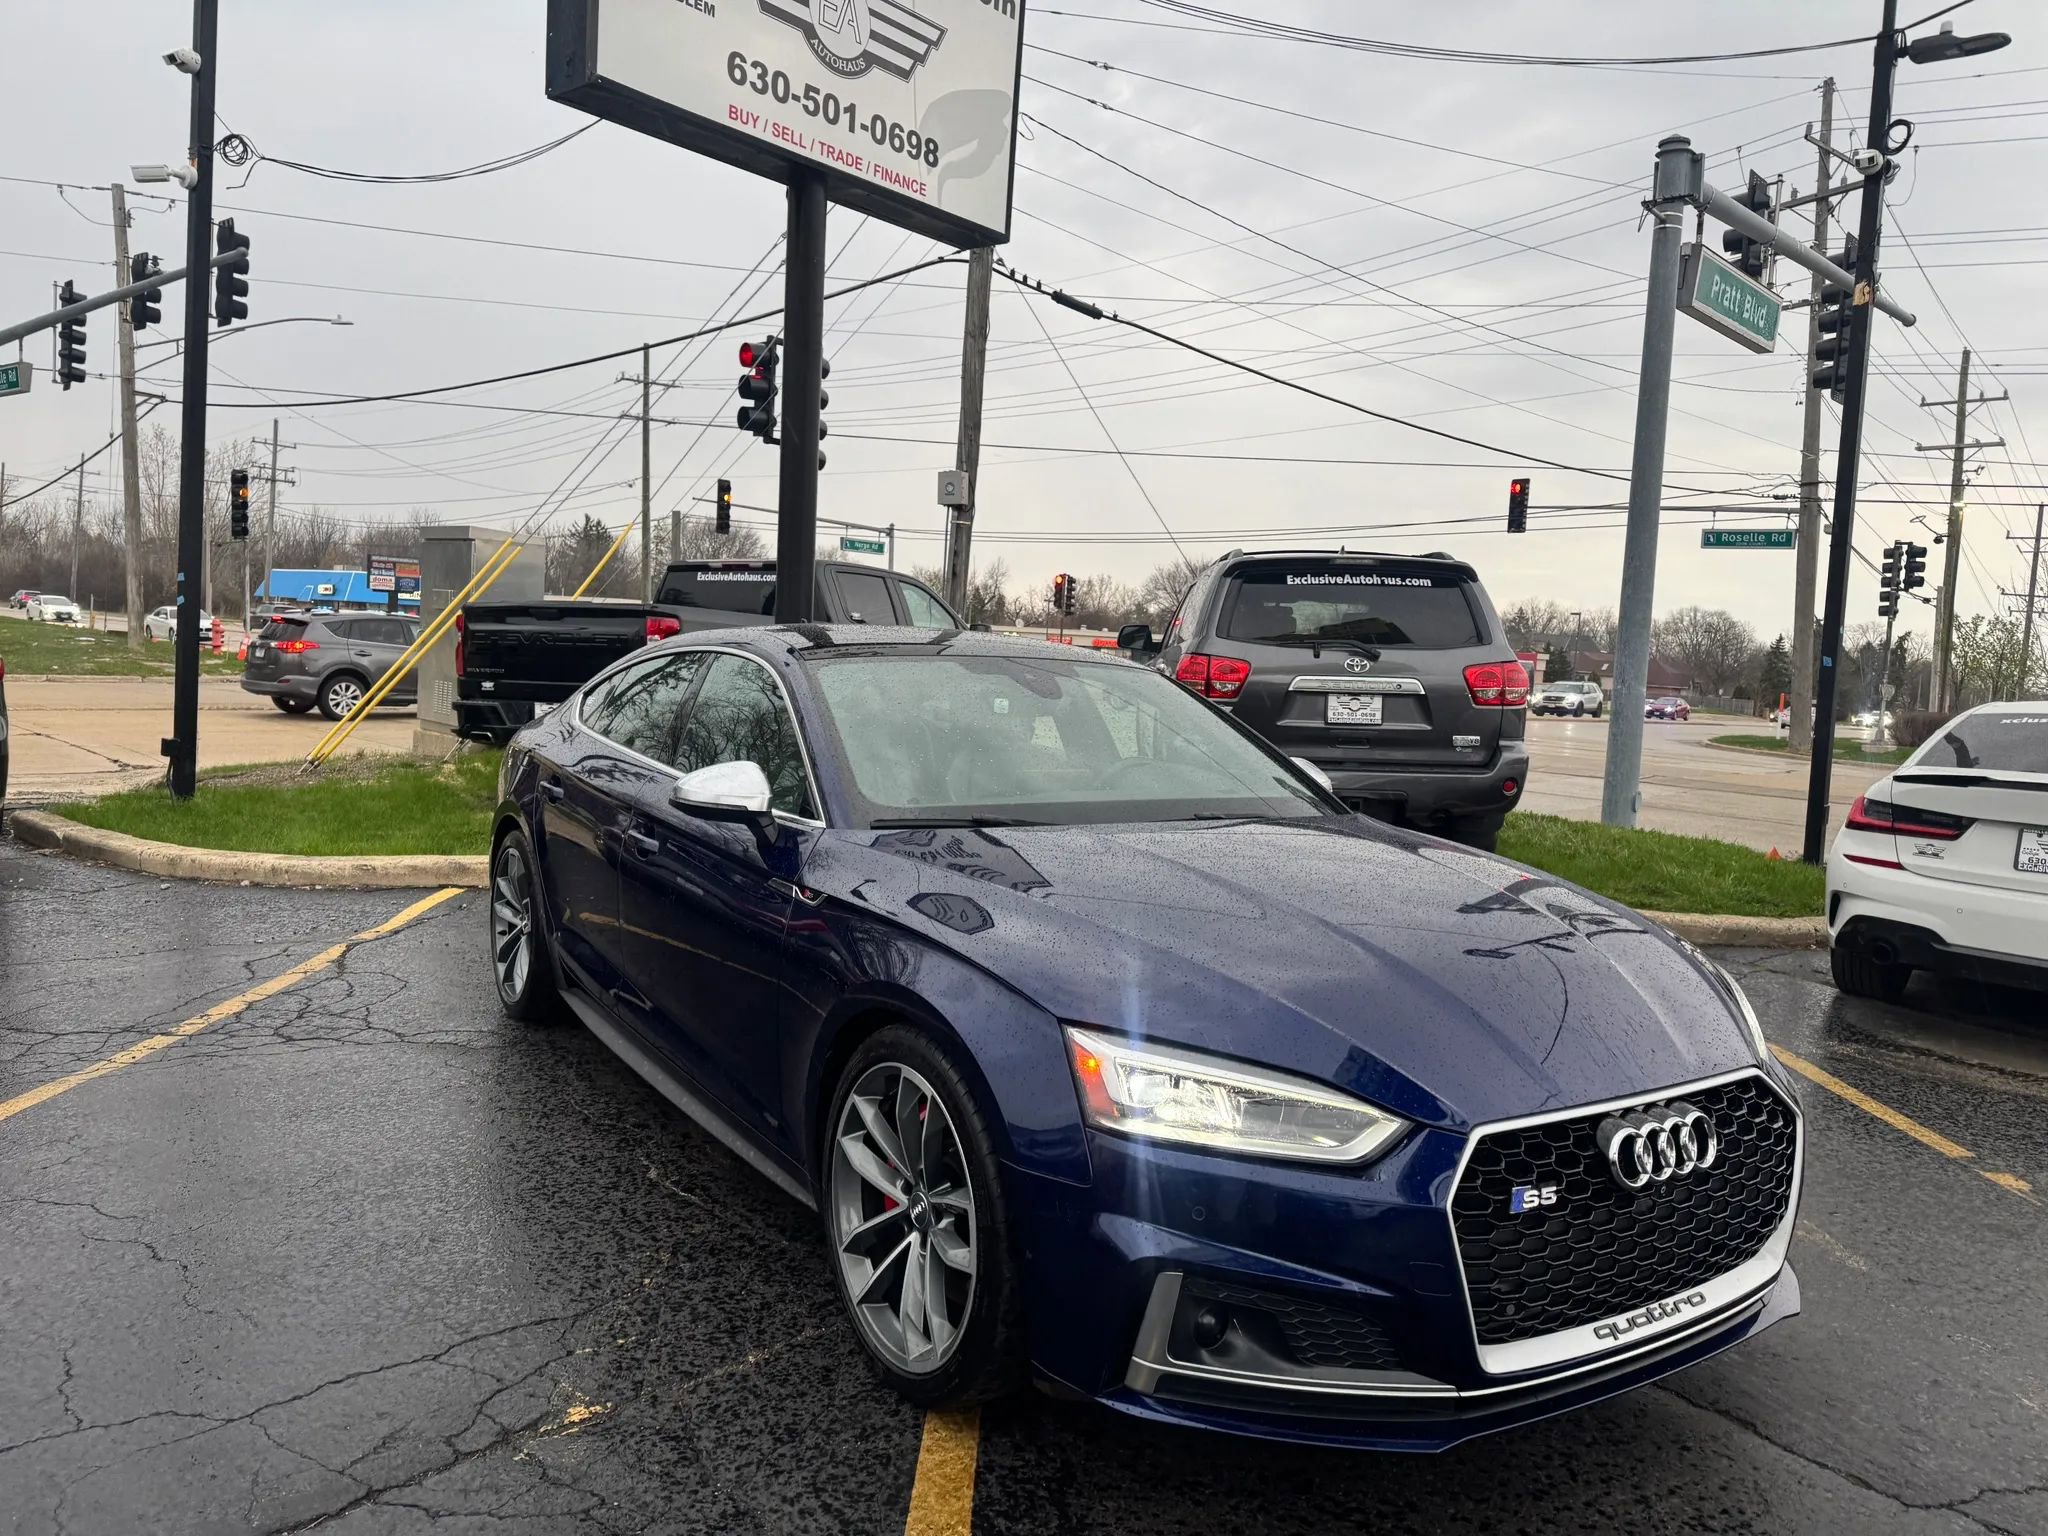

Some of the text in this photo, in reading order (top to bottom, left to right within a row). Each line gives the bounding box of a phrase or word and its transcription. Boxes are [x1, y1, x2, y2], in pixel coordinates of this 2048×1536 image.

[809, 38, 866, 72] AUTOHAUS
[727, 51, 939, 168] 630-501-0698
[728, 104, 760, 129] BUY
[772, 122, 807, 149] SELL
[818, 140, 864, 171] TRADE
[873, 163, 927, 197] FINANCE
[1711, 274, 1767, 328] Pratt Blvd
[1721, 532, 1787, 542] Roselle Rd
[1522, 1185, 1557, 1209] S5
[1593, 1291, 1706, 1341] quattro
